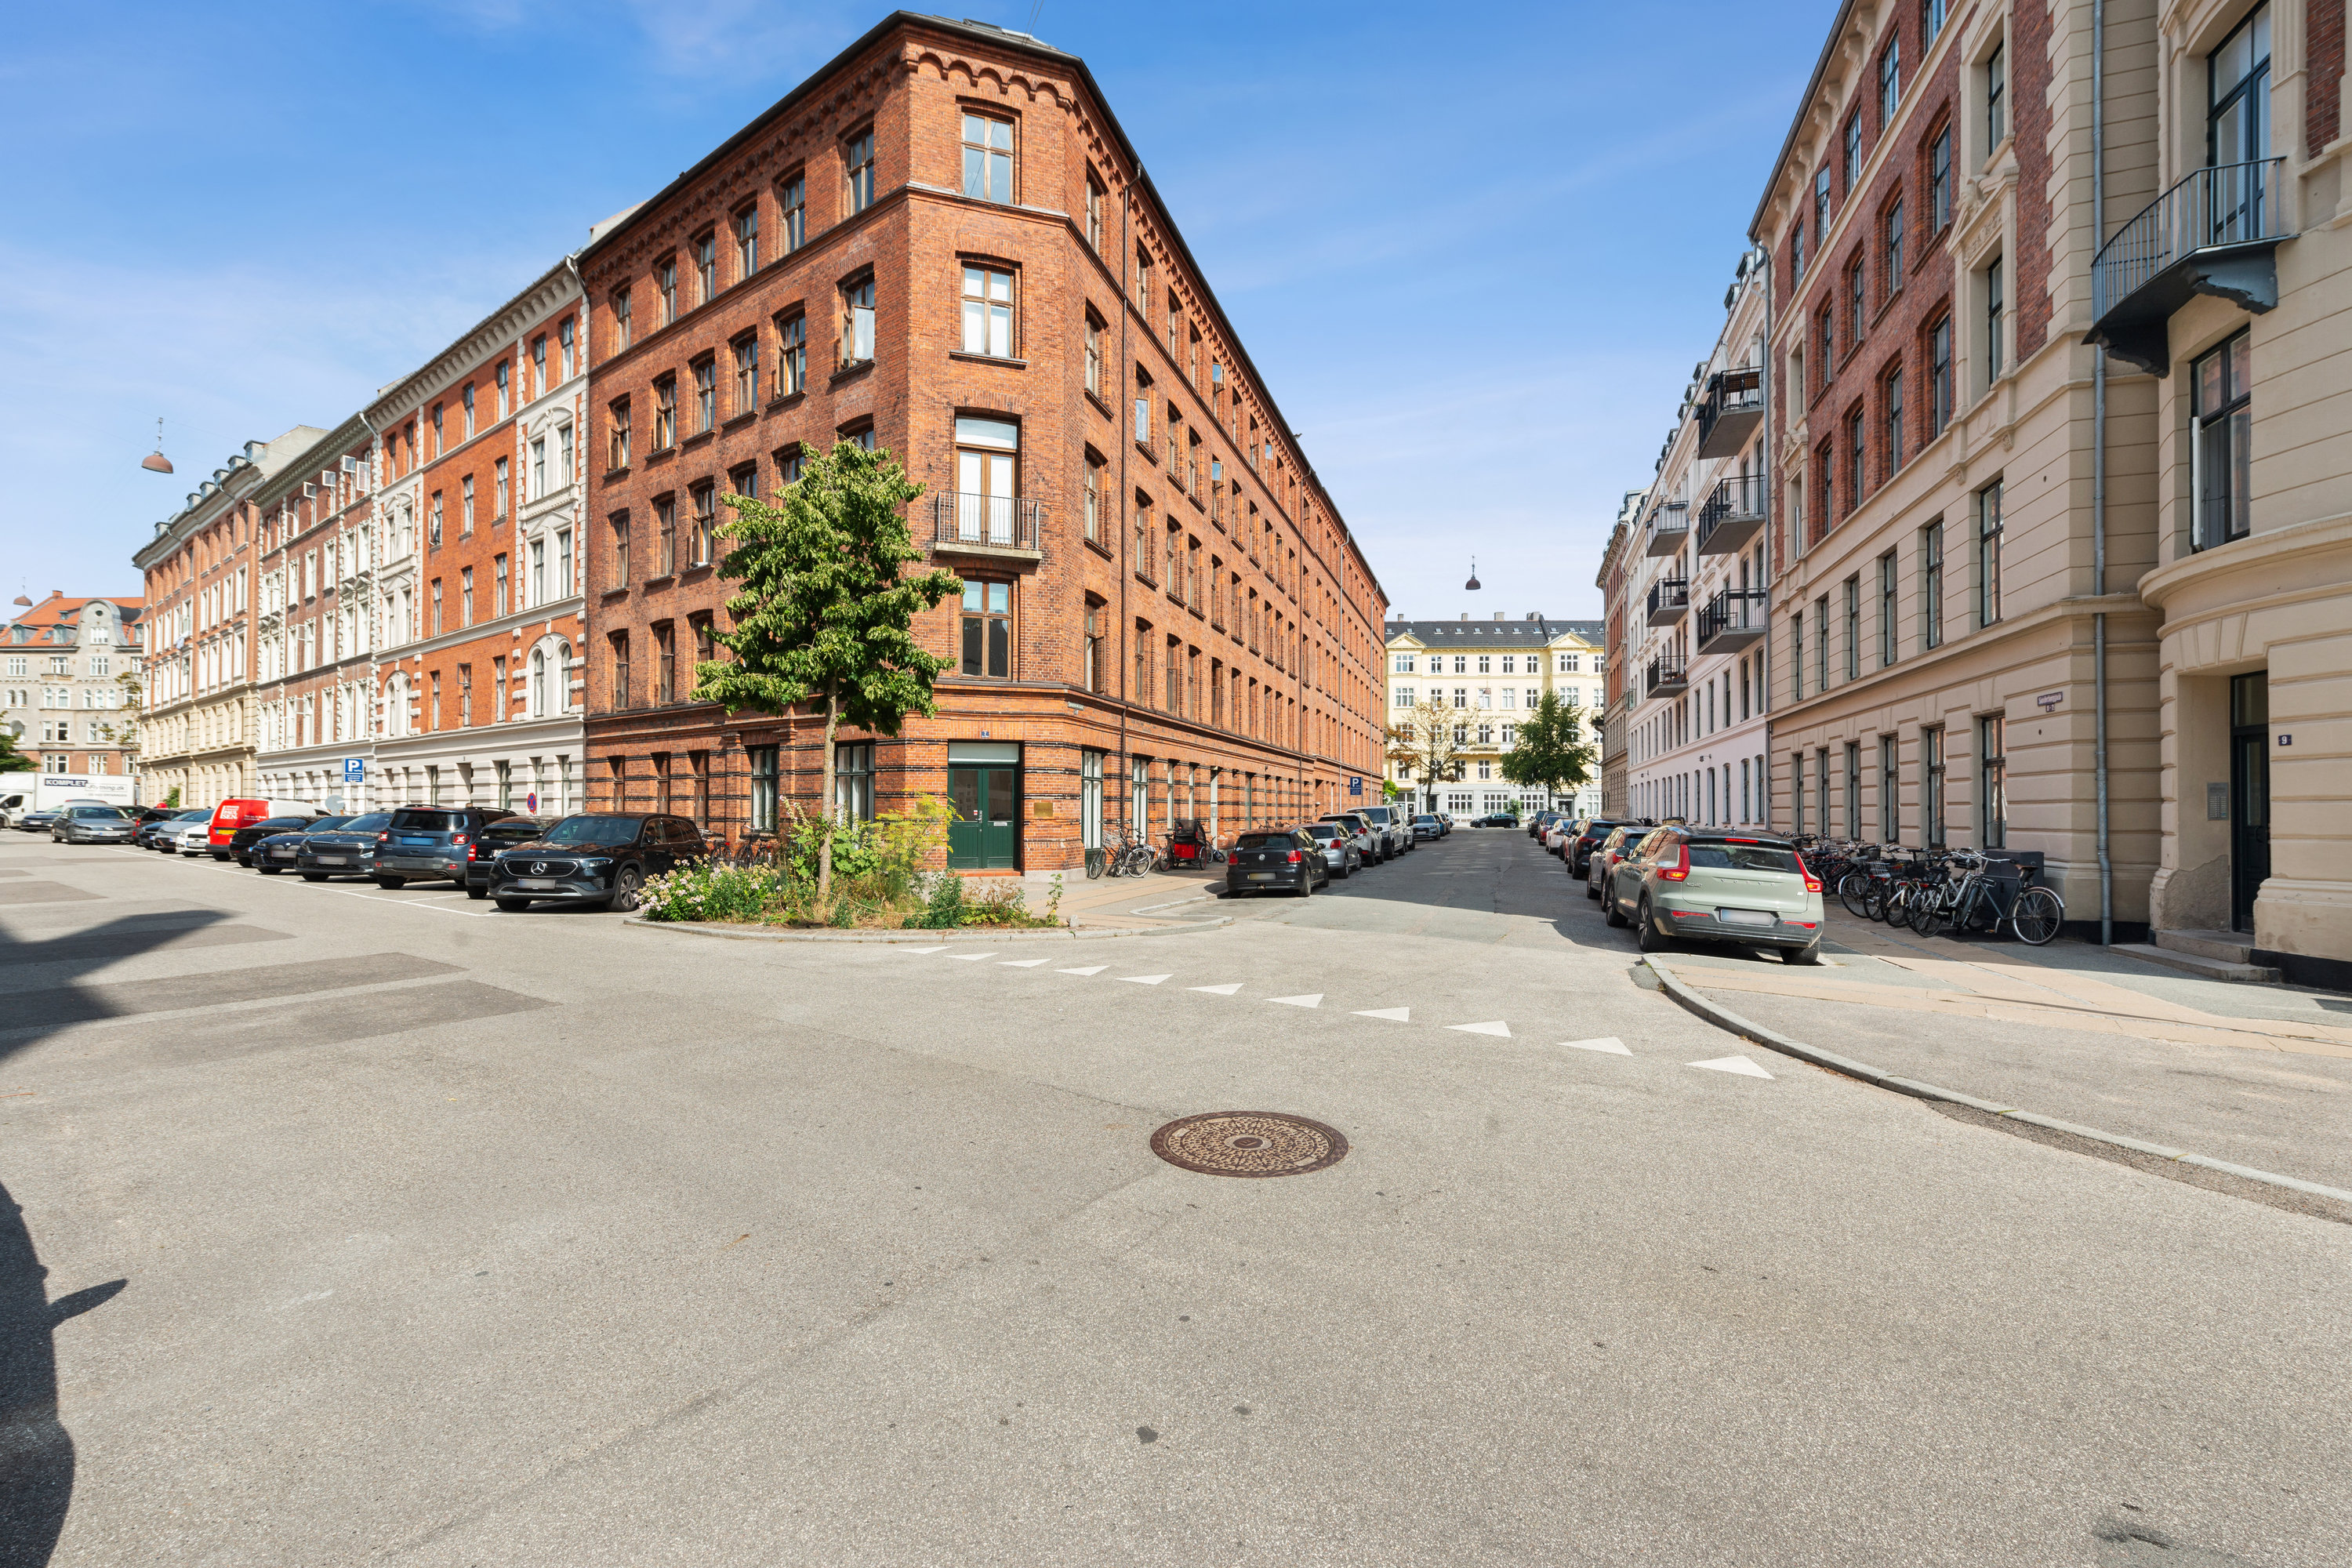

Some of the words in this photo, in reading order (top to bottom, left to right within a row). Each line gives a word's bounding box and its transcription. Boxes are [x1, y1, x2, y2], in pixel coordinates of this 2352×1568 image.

[2281, 735, 2288, 745] 9
[348, 760, 360, 772] P
[1352, 778, 1359, 788] P
